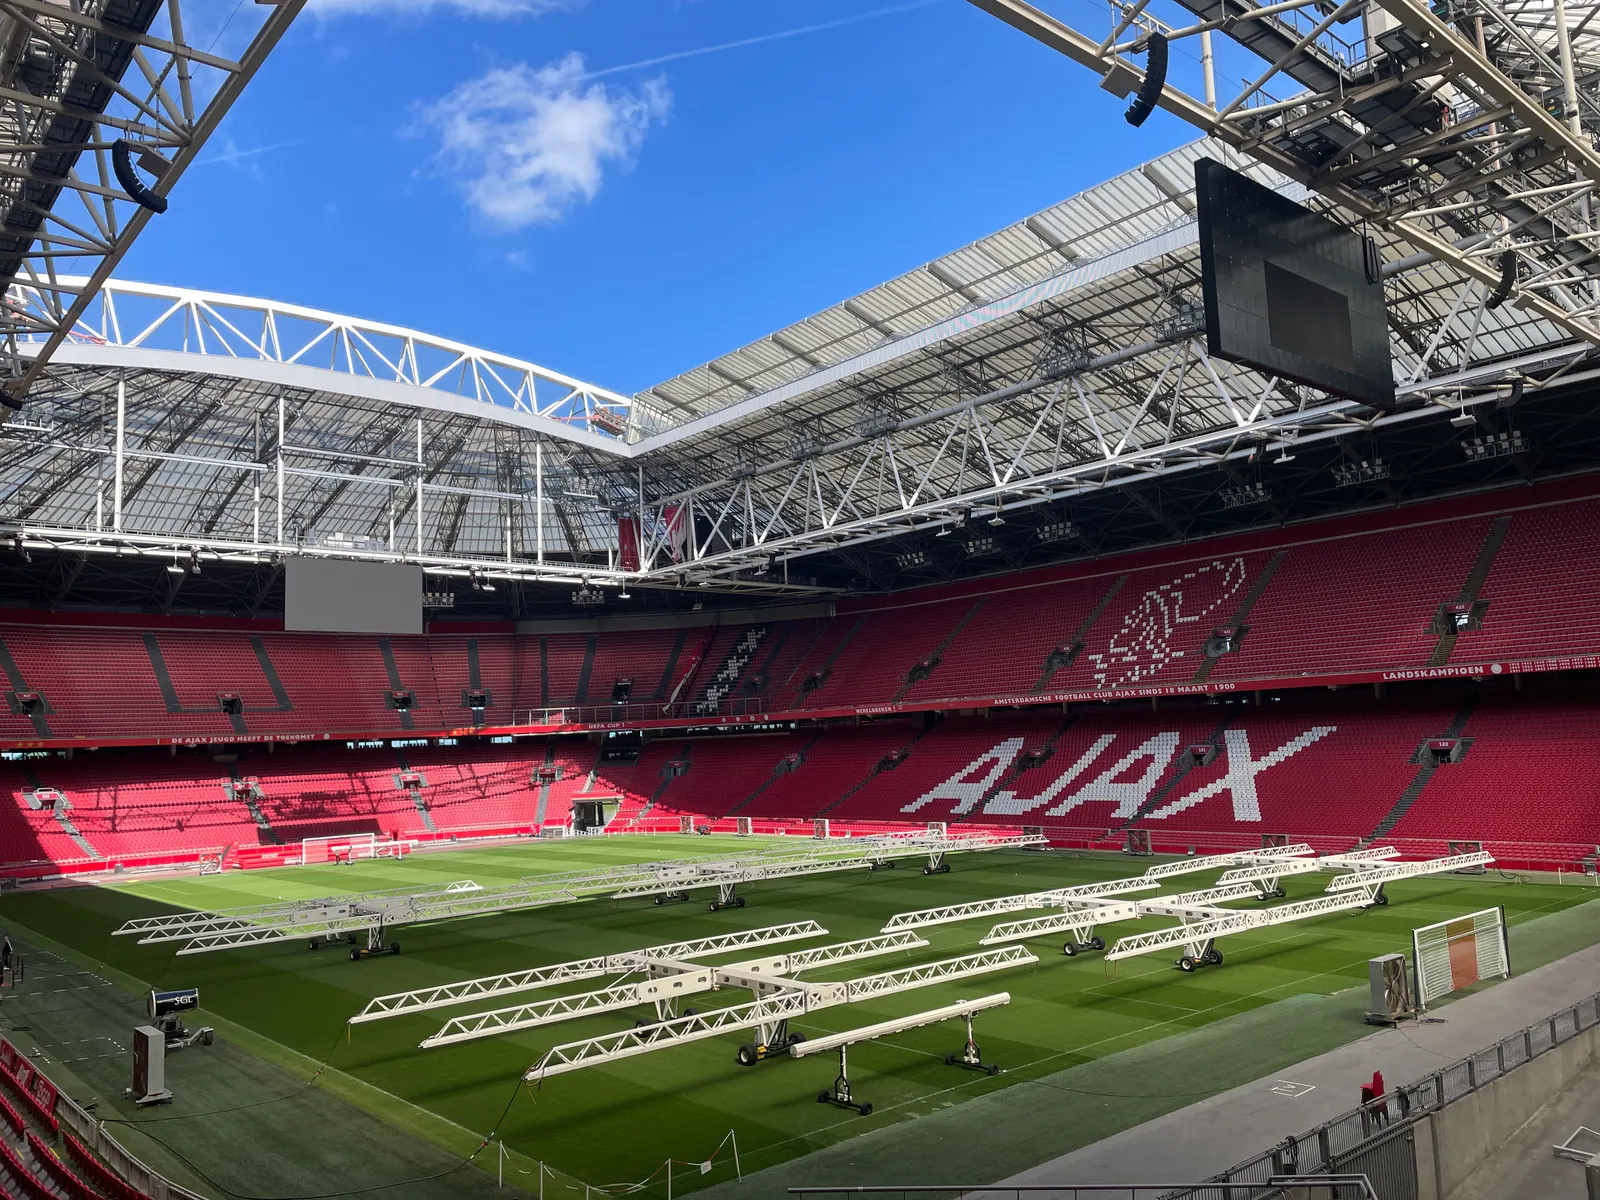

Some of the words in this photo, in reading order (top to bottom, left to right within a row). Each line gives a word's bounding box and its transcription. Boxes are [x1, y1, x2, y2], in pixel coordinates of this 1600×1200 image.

[1383, 665, 1484, 680] LANDSKAMPIOEN
[994, 695, 1052, 705] AMSTERDAMSCHE
[1054, 692, 1091, 701] FOOTBALL
[1115, 689, 1136, 698] AJAX
[1139, 687, 1162, 695] SINDS
[1165, 686, 1175, 694] 18
[1177, 684, 1209, 693] MAART
[185, 736, 207, 744] AJAX
[209, 736, 235, 744] JEUGD
[276, 733, 316, 741] TOEKOMST
[900, 726, 1337, 821] AJAX
[174, 995, 193, 1006] SGL
